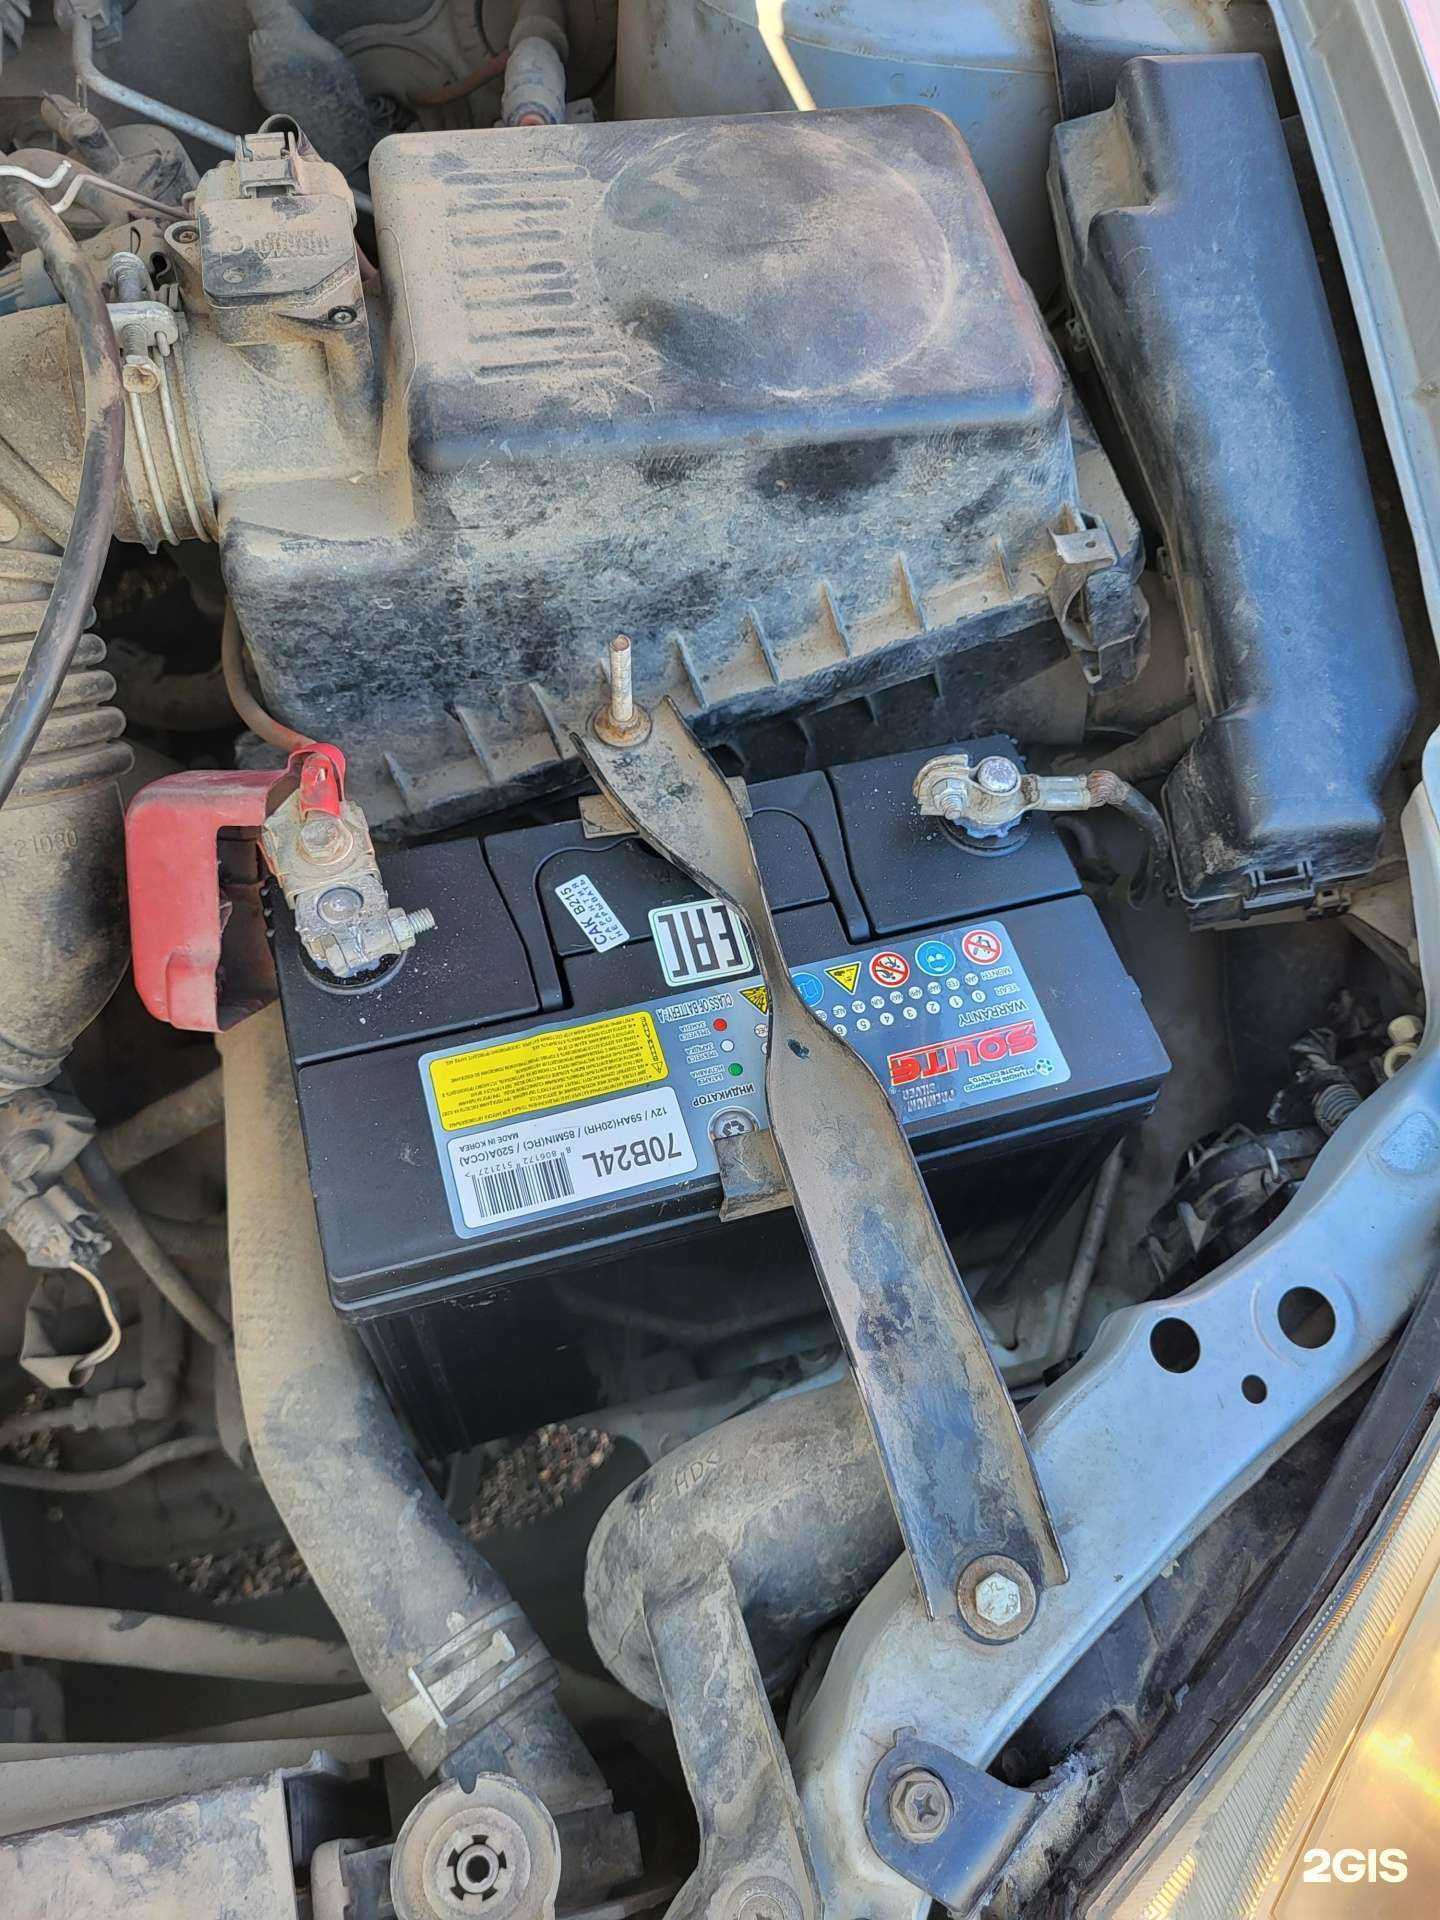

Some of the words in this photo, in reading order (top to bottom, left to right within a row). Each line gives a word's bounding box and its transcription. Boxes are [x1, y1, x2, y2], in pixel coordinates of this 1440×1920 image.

[657, 905, 744, 977] EAC
[956, 997, 1026, 1027] WARRANTY
[691, 1083, 754, 1107] ИНДИКАТОР
[905, 1087, 955, 1111] PREMIUM
[650, 1106, 666, 1117] 12V
[582, 1112, 642, 1135] 59AH(20HR)
[458, 1140, 486, 1152] KOREA
[496, 1131, 518, 1142] MADE
[522, 1129, 575, 1150] 85MIN(RC)
[458, 1144, 514, 1166] 520A(CCA)
[522, 1149, 557, 1164] 806172
[580, 1131, 682, 1179] 70B24L
[477, 1161, 512, 1175] 512127
